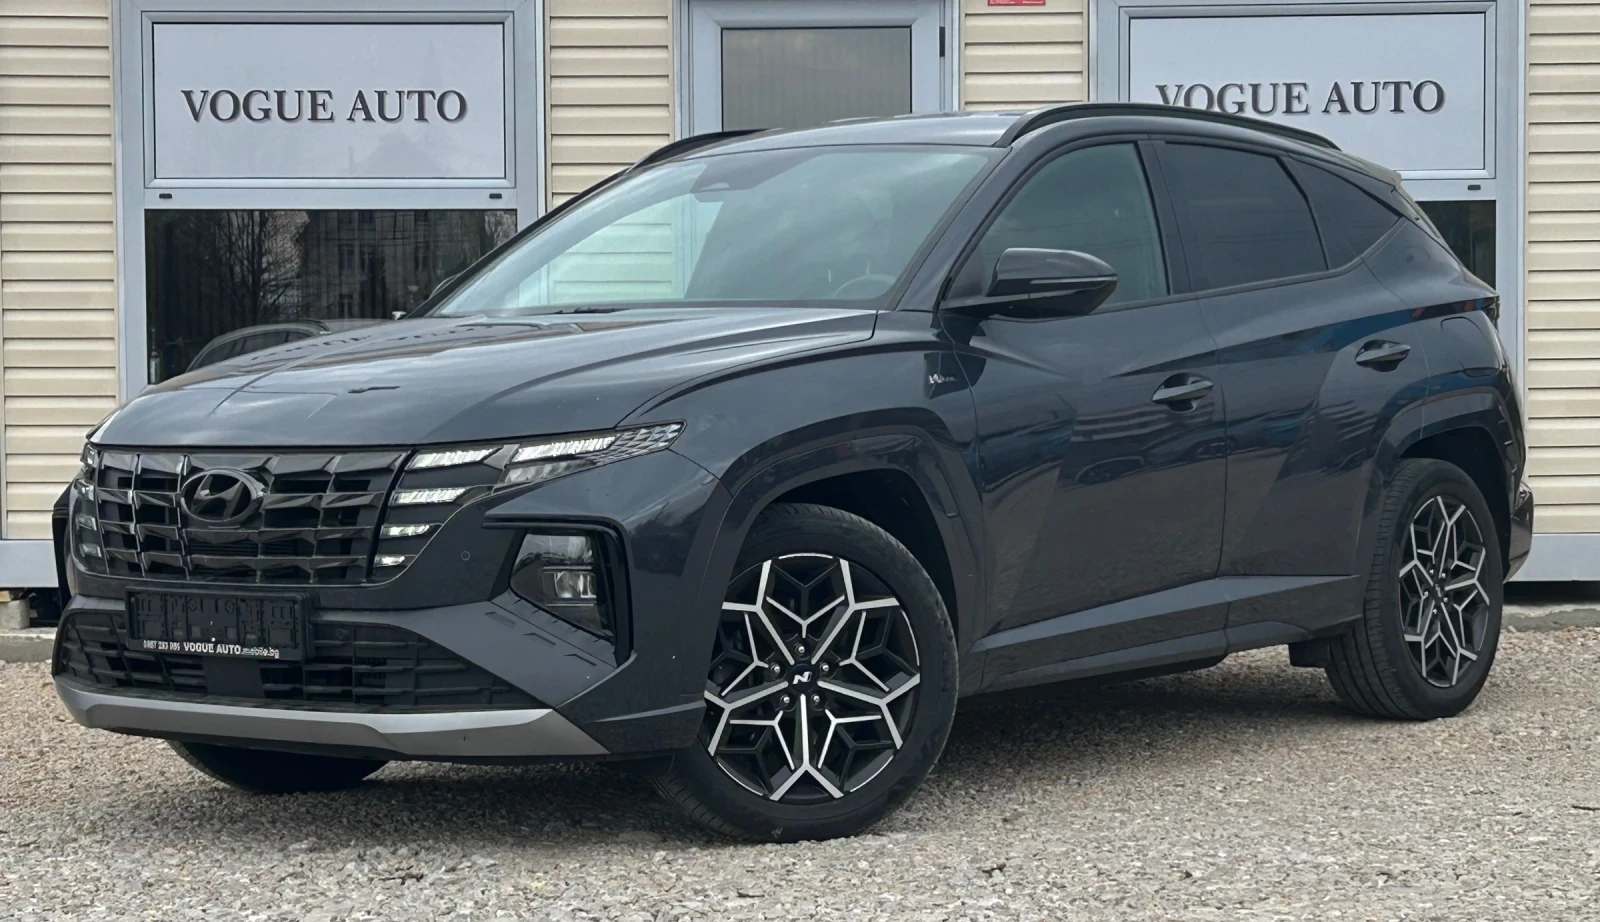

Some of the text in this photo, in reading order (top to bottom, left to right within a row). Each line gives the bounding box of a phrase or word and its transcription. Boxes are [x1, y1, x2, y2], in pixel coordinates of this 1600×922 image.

[181, 89, 467, 123] VOGUE AUTO
[1155, 80, 1445, 115] VOGUE AUTO
[183, 641, 214, 653] VOGUE
